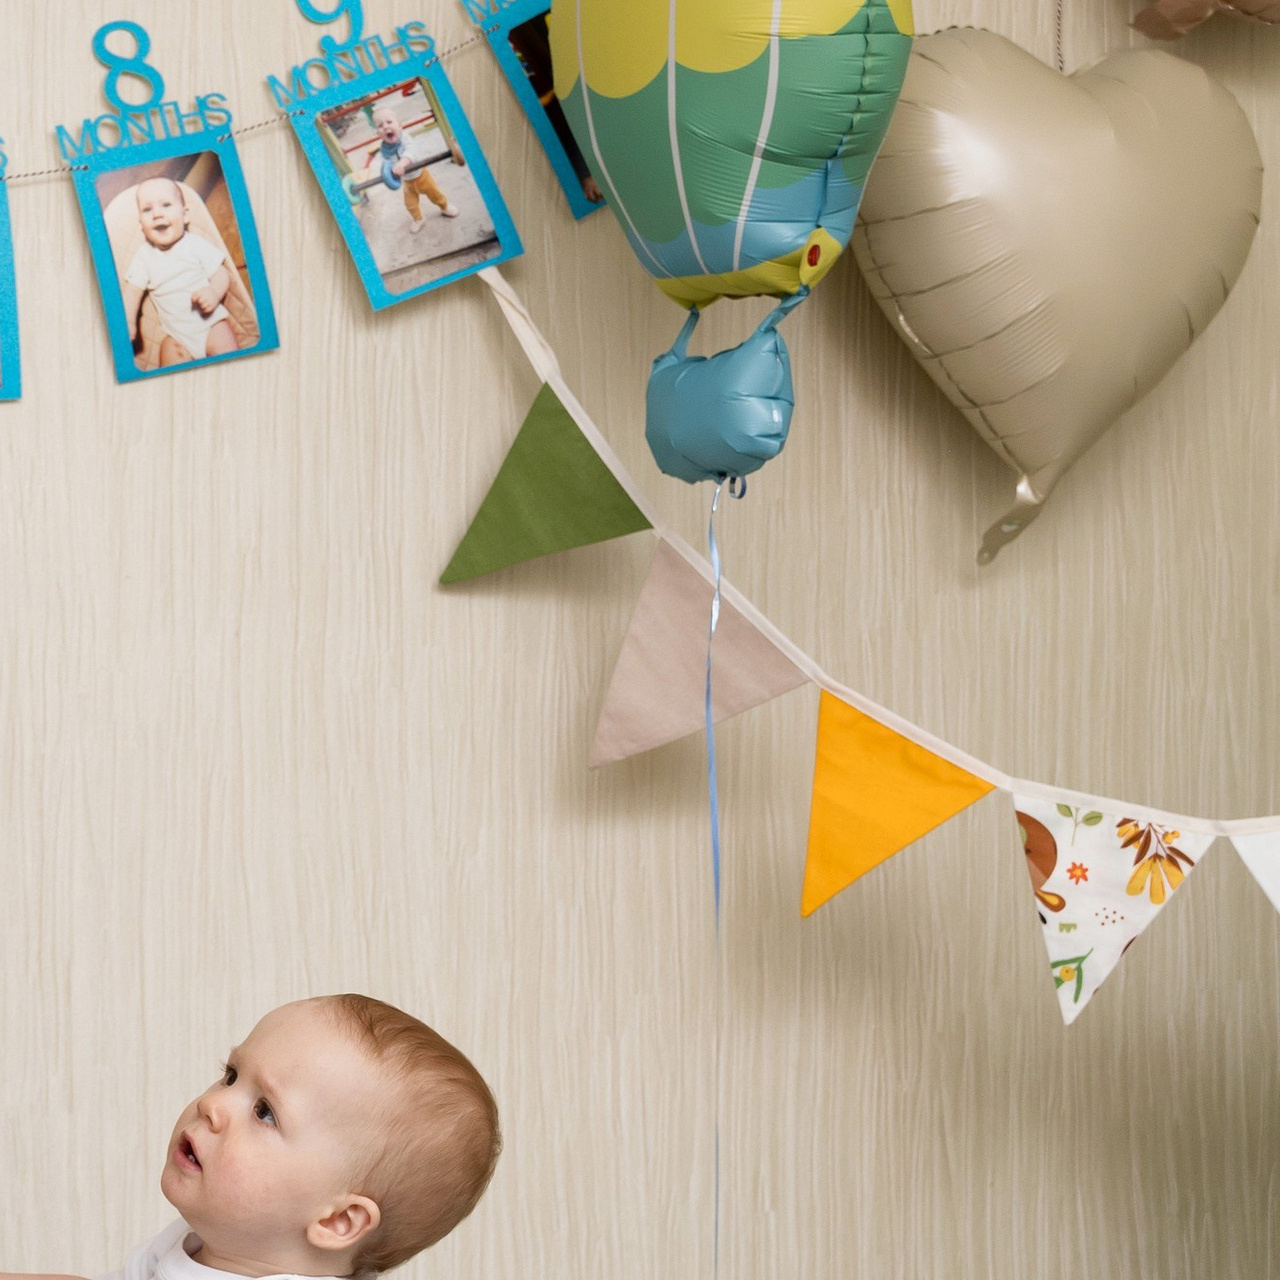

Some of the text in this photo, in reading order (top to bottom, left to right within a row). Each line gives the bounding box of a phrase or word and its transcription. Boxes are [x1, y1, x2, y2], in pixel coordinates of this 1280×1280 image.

[92, 20, 165, 108] 8
[265, 21, 435, 110] MONTHS
[55, 92, 233, 160] MONTHS
